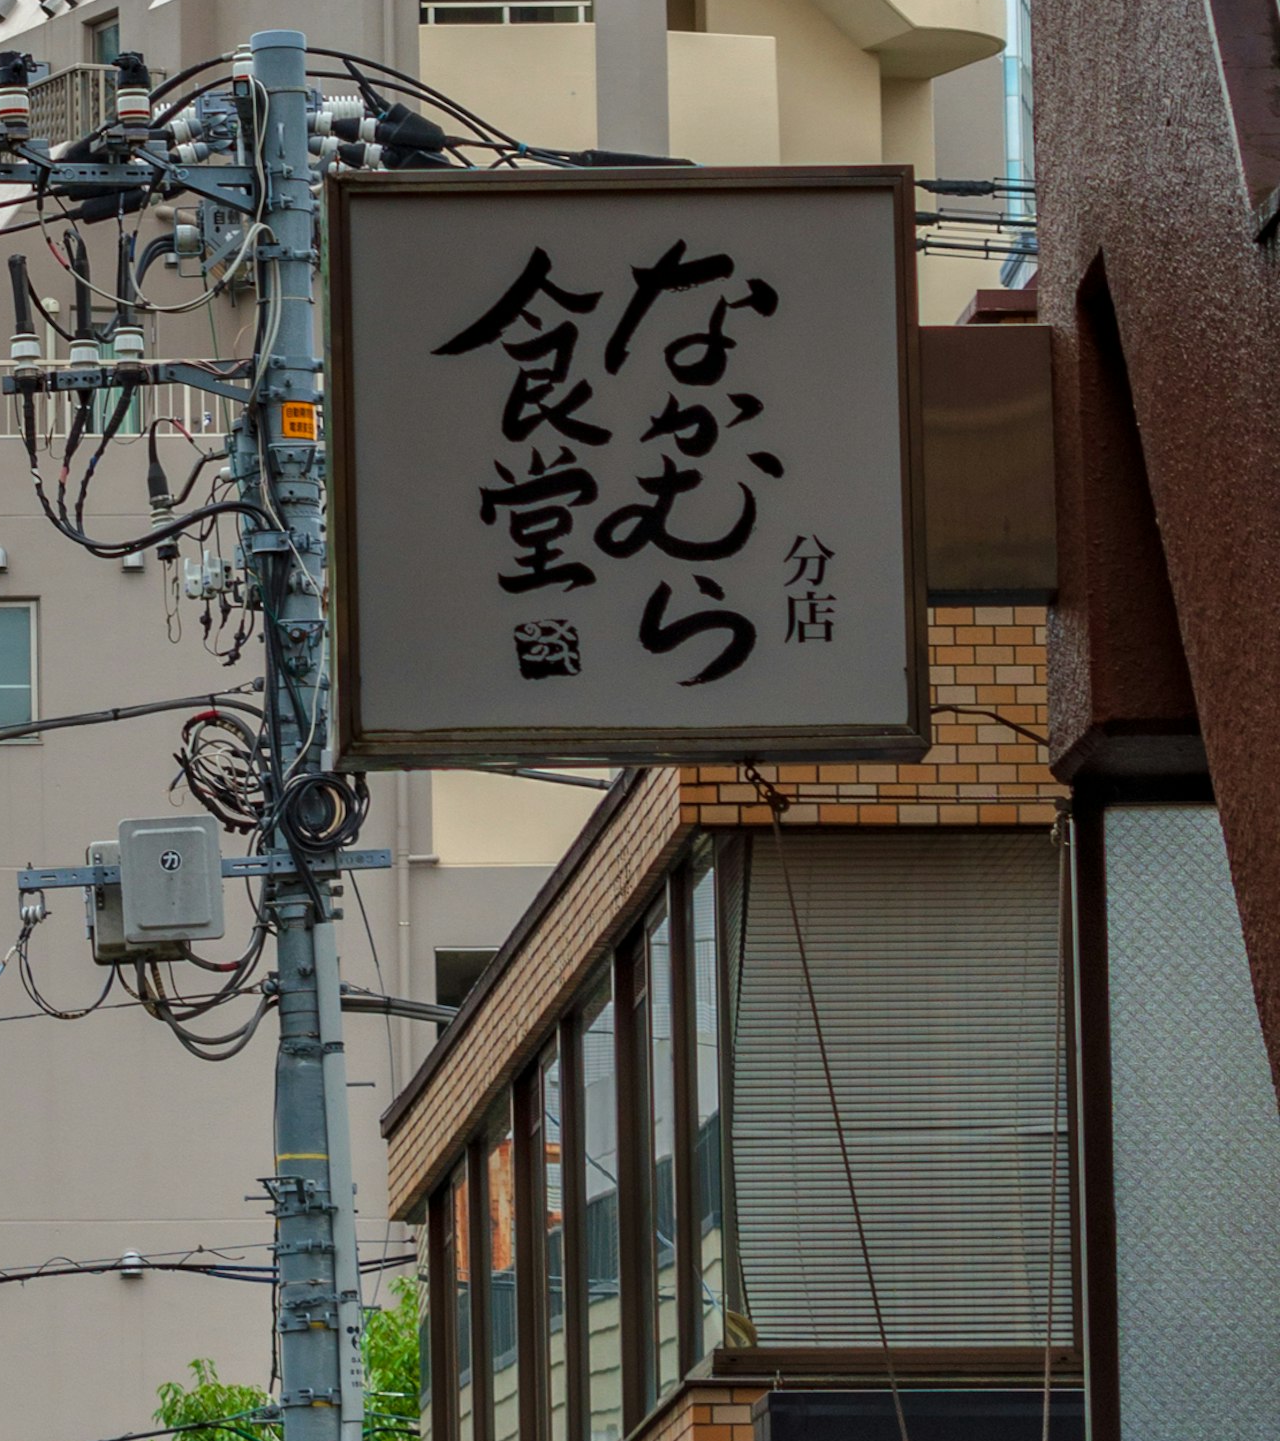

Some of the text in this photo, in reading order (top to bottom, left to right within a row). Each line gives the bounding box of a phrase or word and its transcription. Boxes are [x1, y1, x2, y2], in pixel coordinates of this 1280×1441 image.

[429, 246, 613, 594] 食堂
[593, 238, 784, 687] なかむら
[783, 533, 837, 645] 分店
